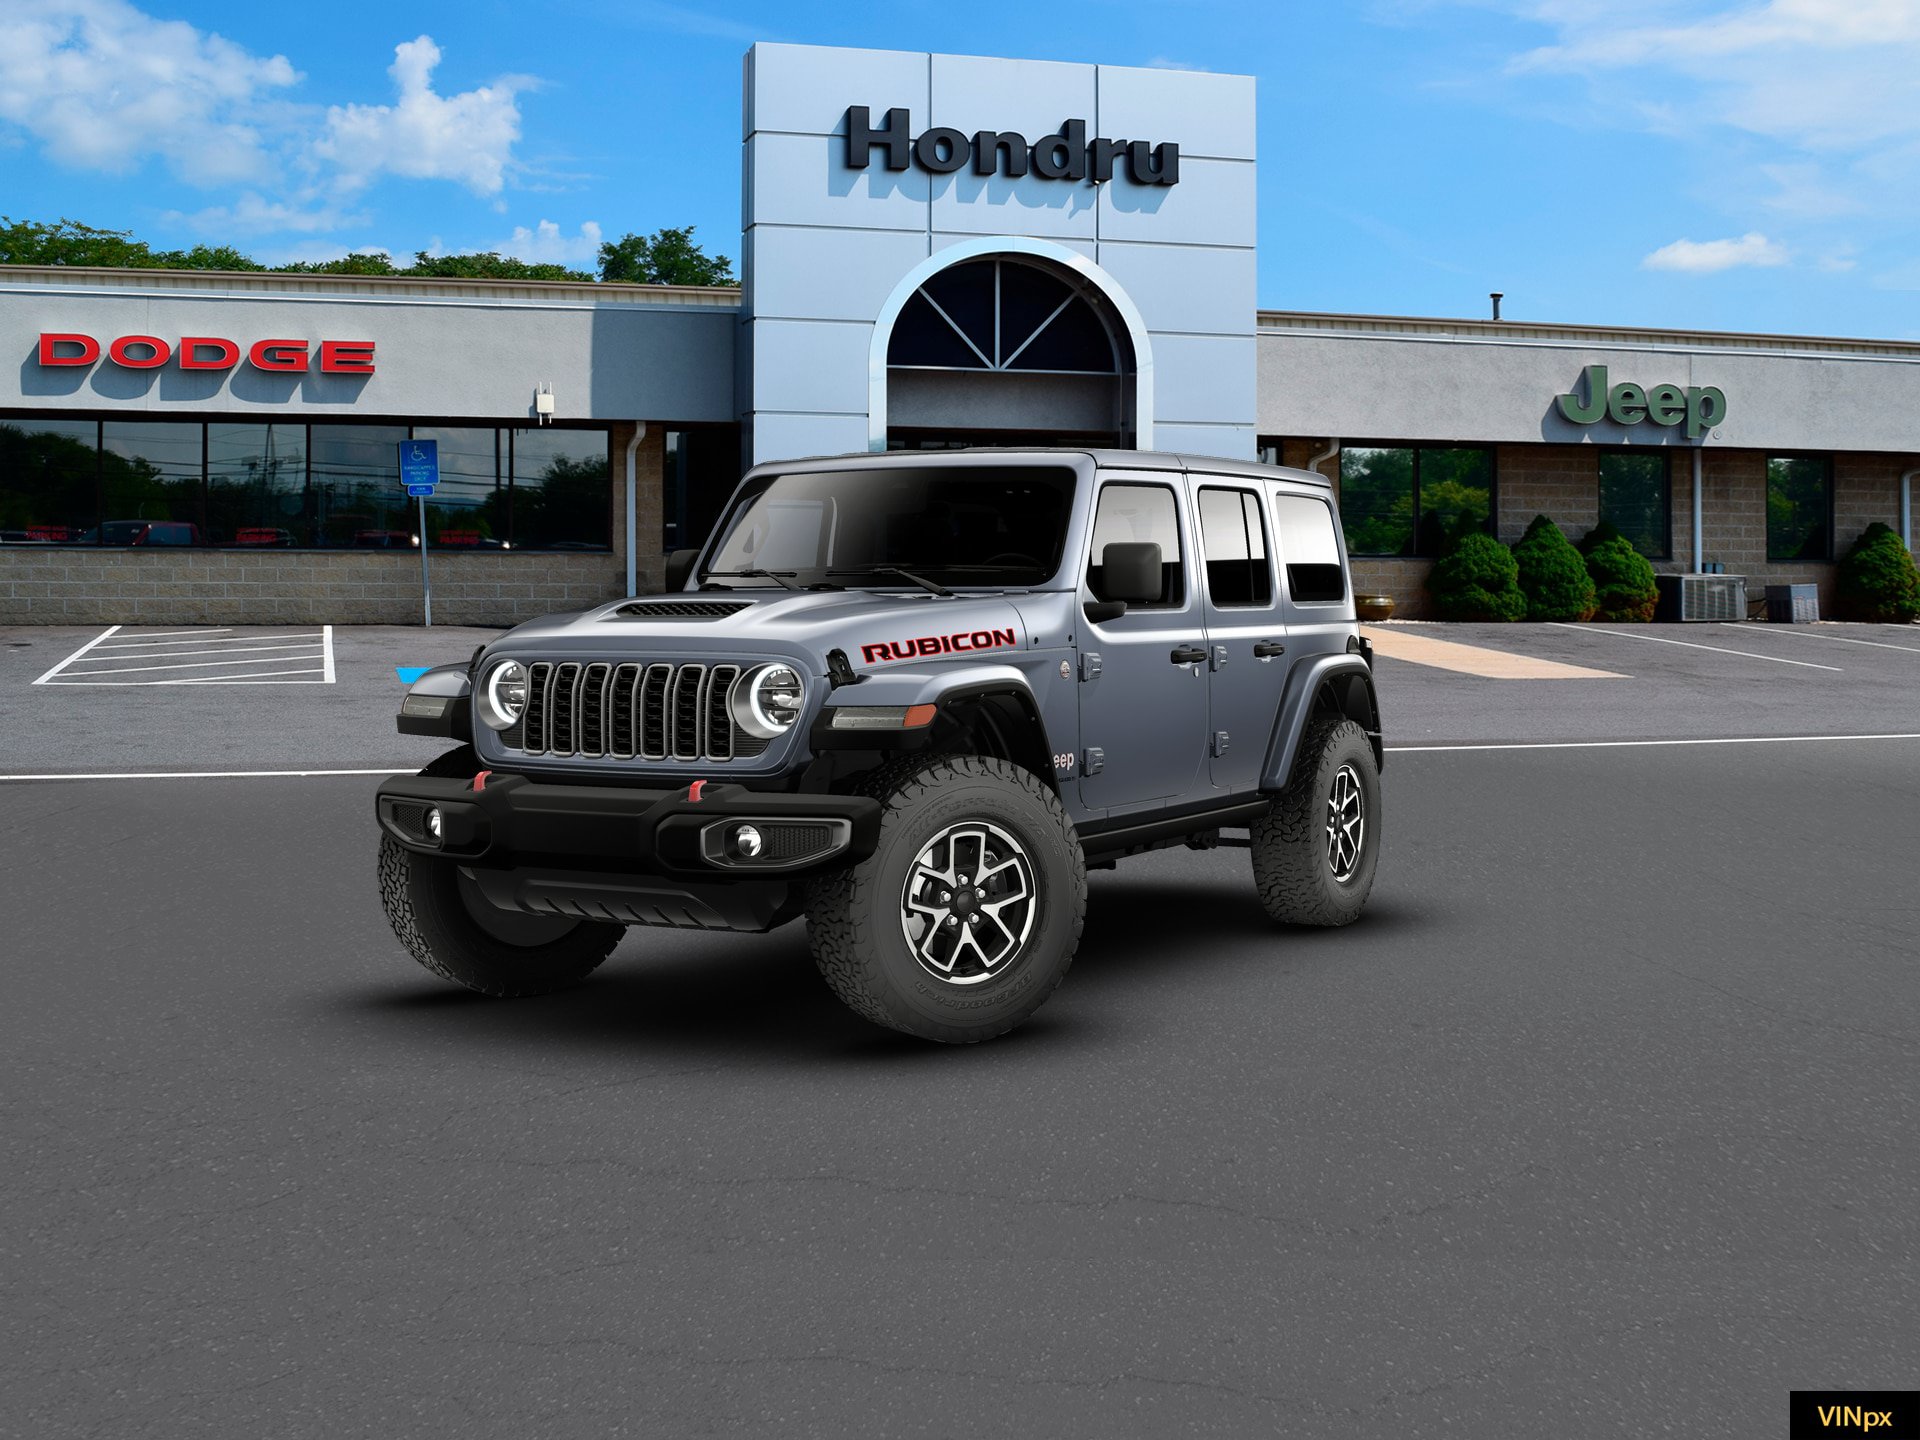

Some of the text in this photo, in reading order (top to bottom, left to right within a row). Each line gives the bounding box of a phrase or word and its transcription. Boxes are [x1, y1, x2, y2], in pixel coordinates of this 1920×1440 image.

[846, 105, 1180, 185] Hondru
[38, 333, 376, 374] DODGE
[1555, 364, 1727, 439] Jeep
[861, 628, 1017, 664] RUBICON
[1053, 752, 1075, 771] eep
